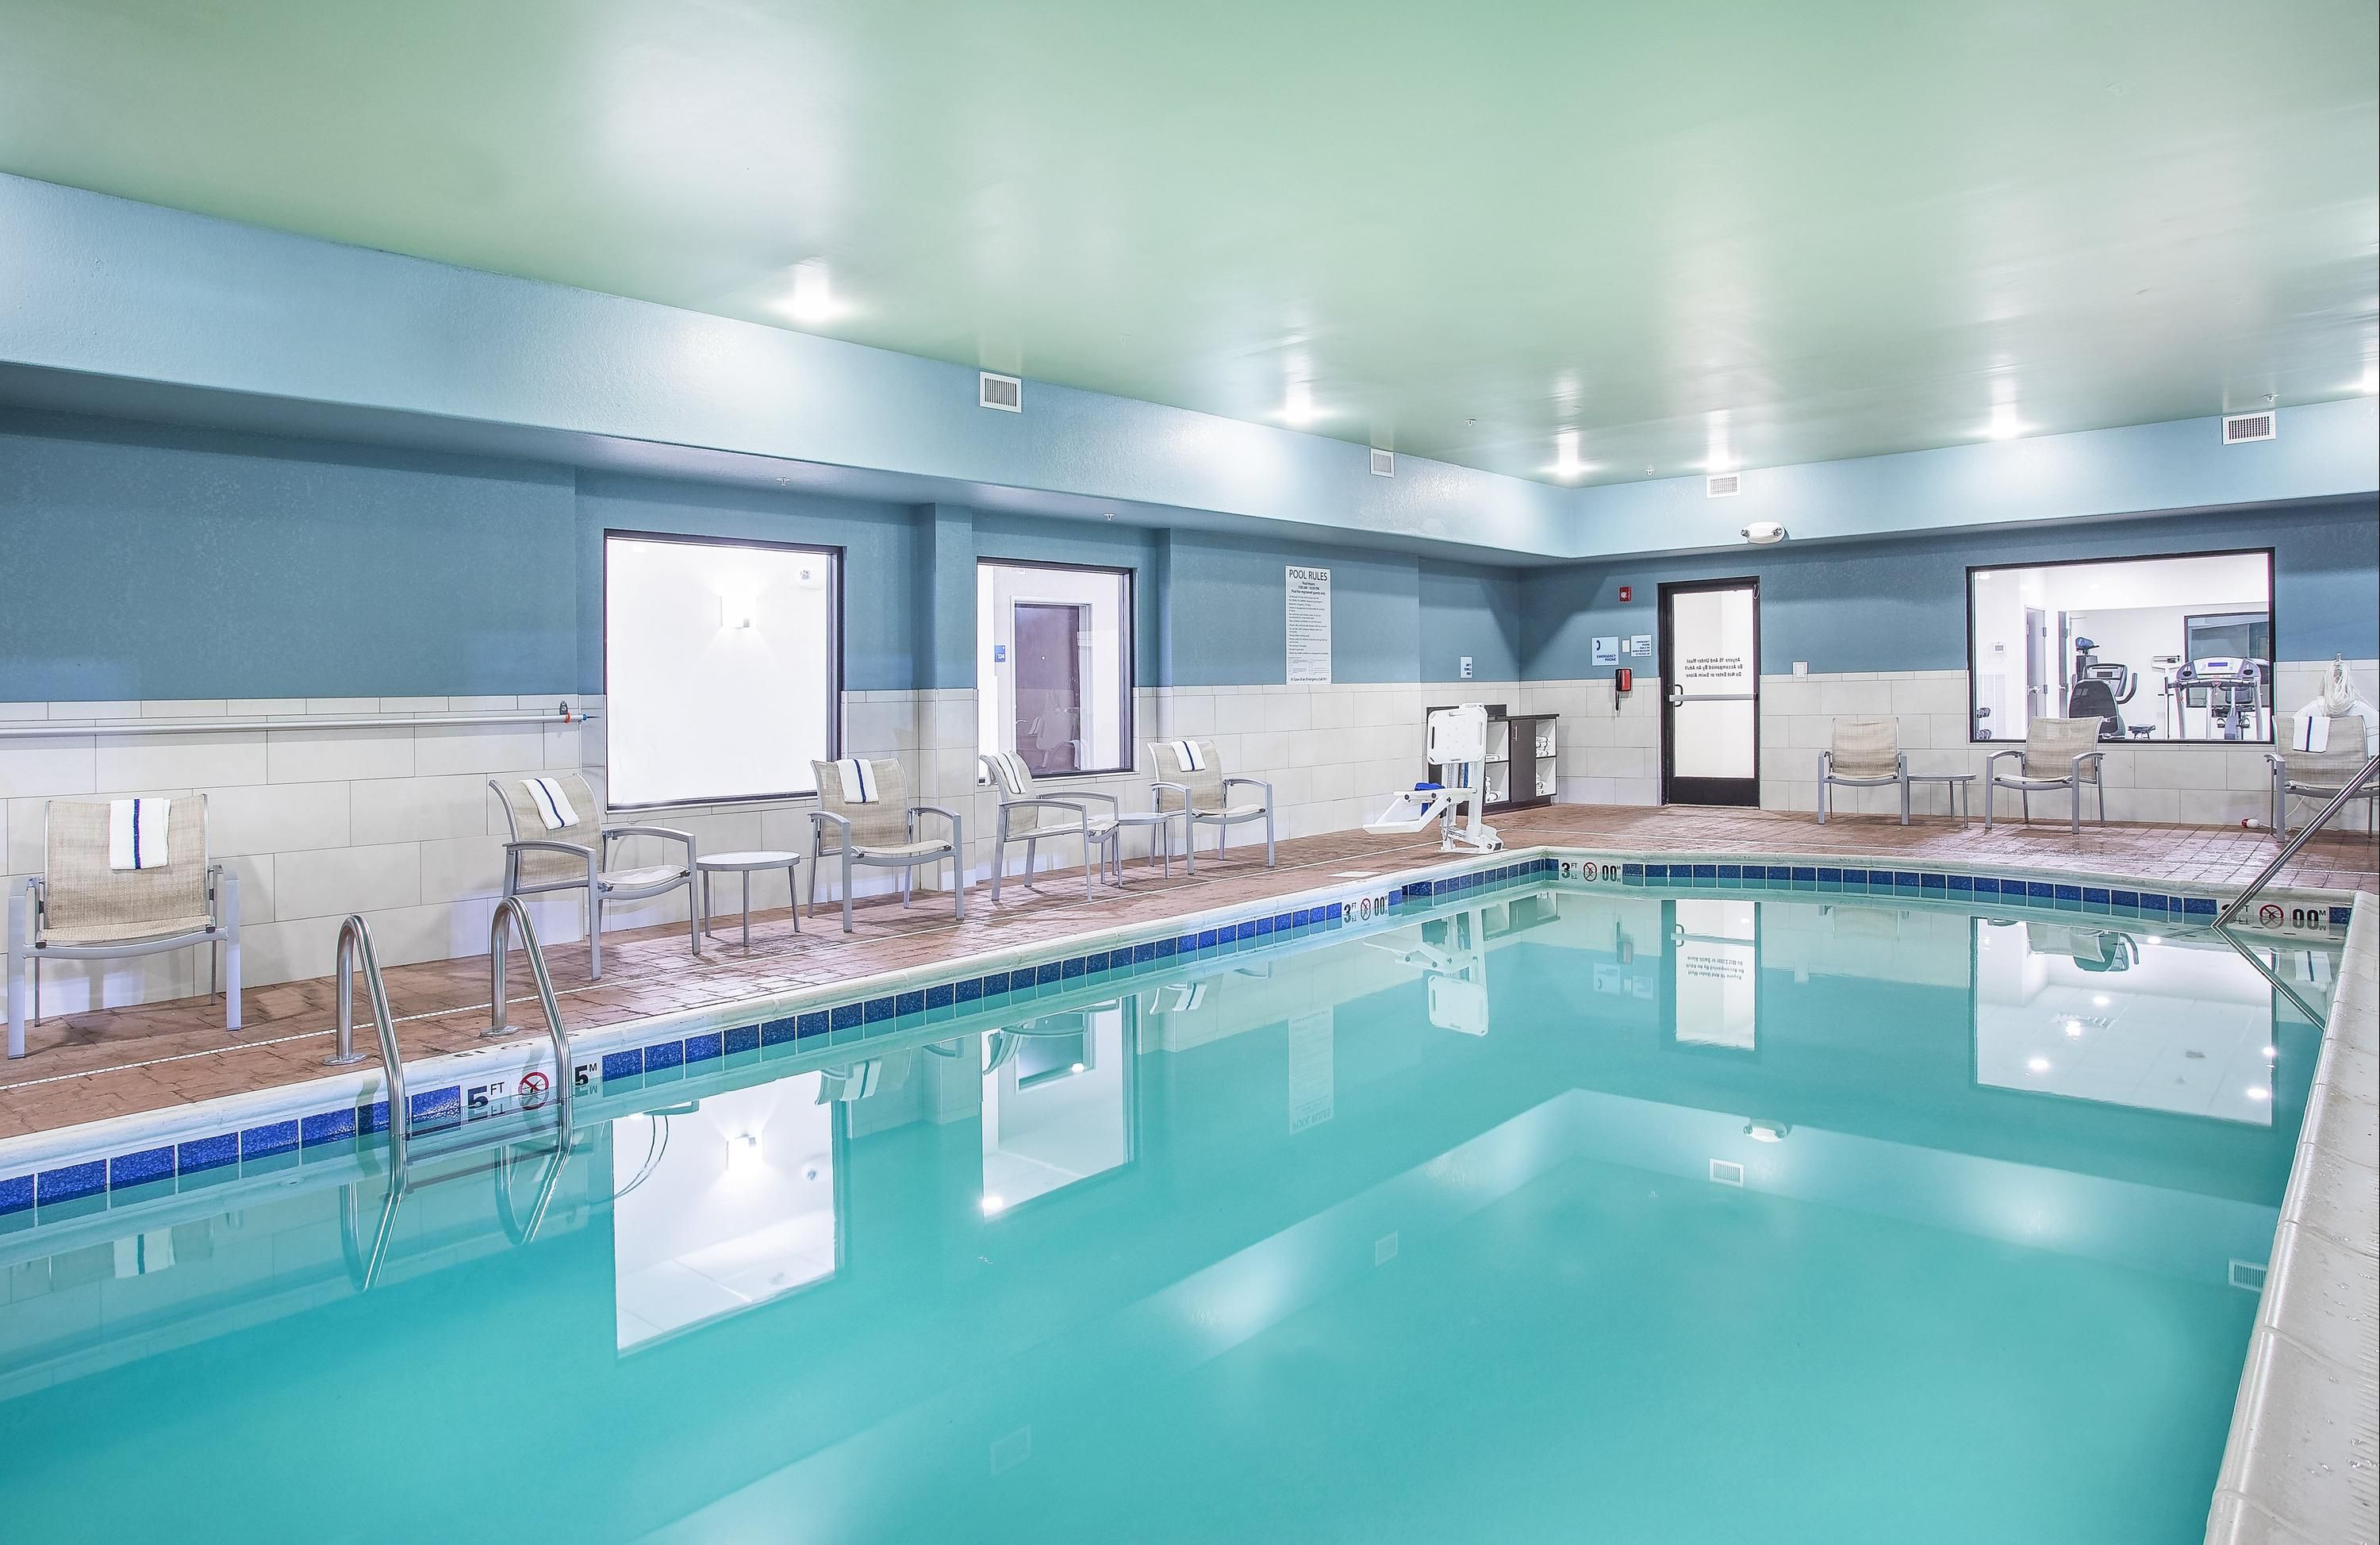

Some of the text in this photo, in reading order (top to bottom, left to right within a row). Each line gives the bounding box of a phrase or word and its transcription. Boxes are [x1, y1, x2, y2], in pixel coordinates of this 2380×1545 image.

[1289, 569, 1328, 581] POOL RULES
[1562, 862, 1570, 878] 3
[589, 1063, 597, 1072] M
[468, 1082, 505, 1109] 5 FT
